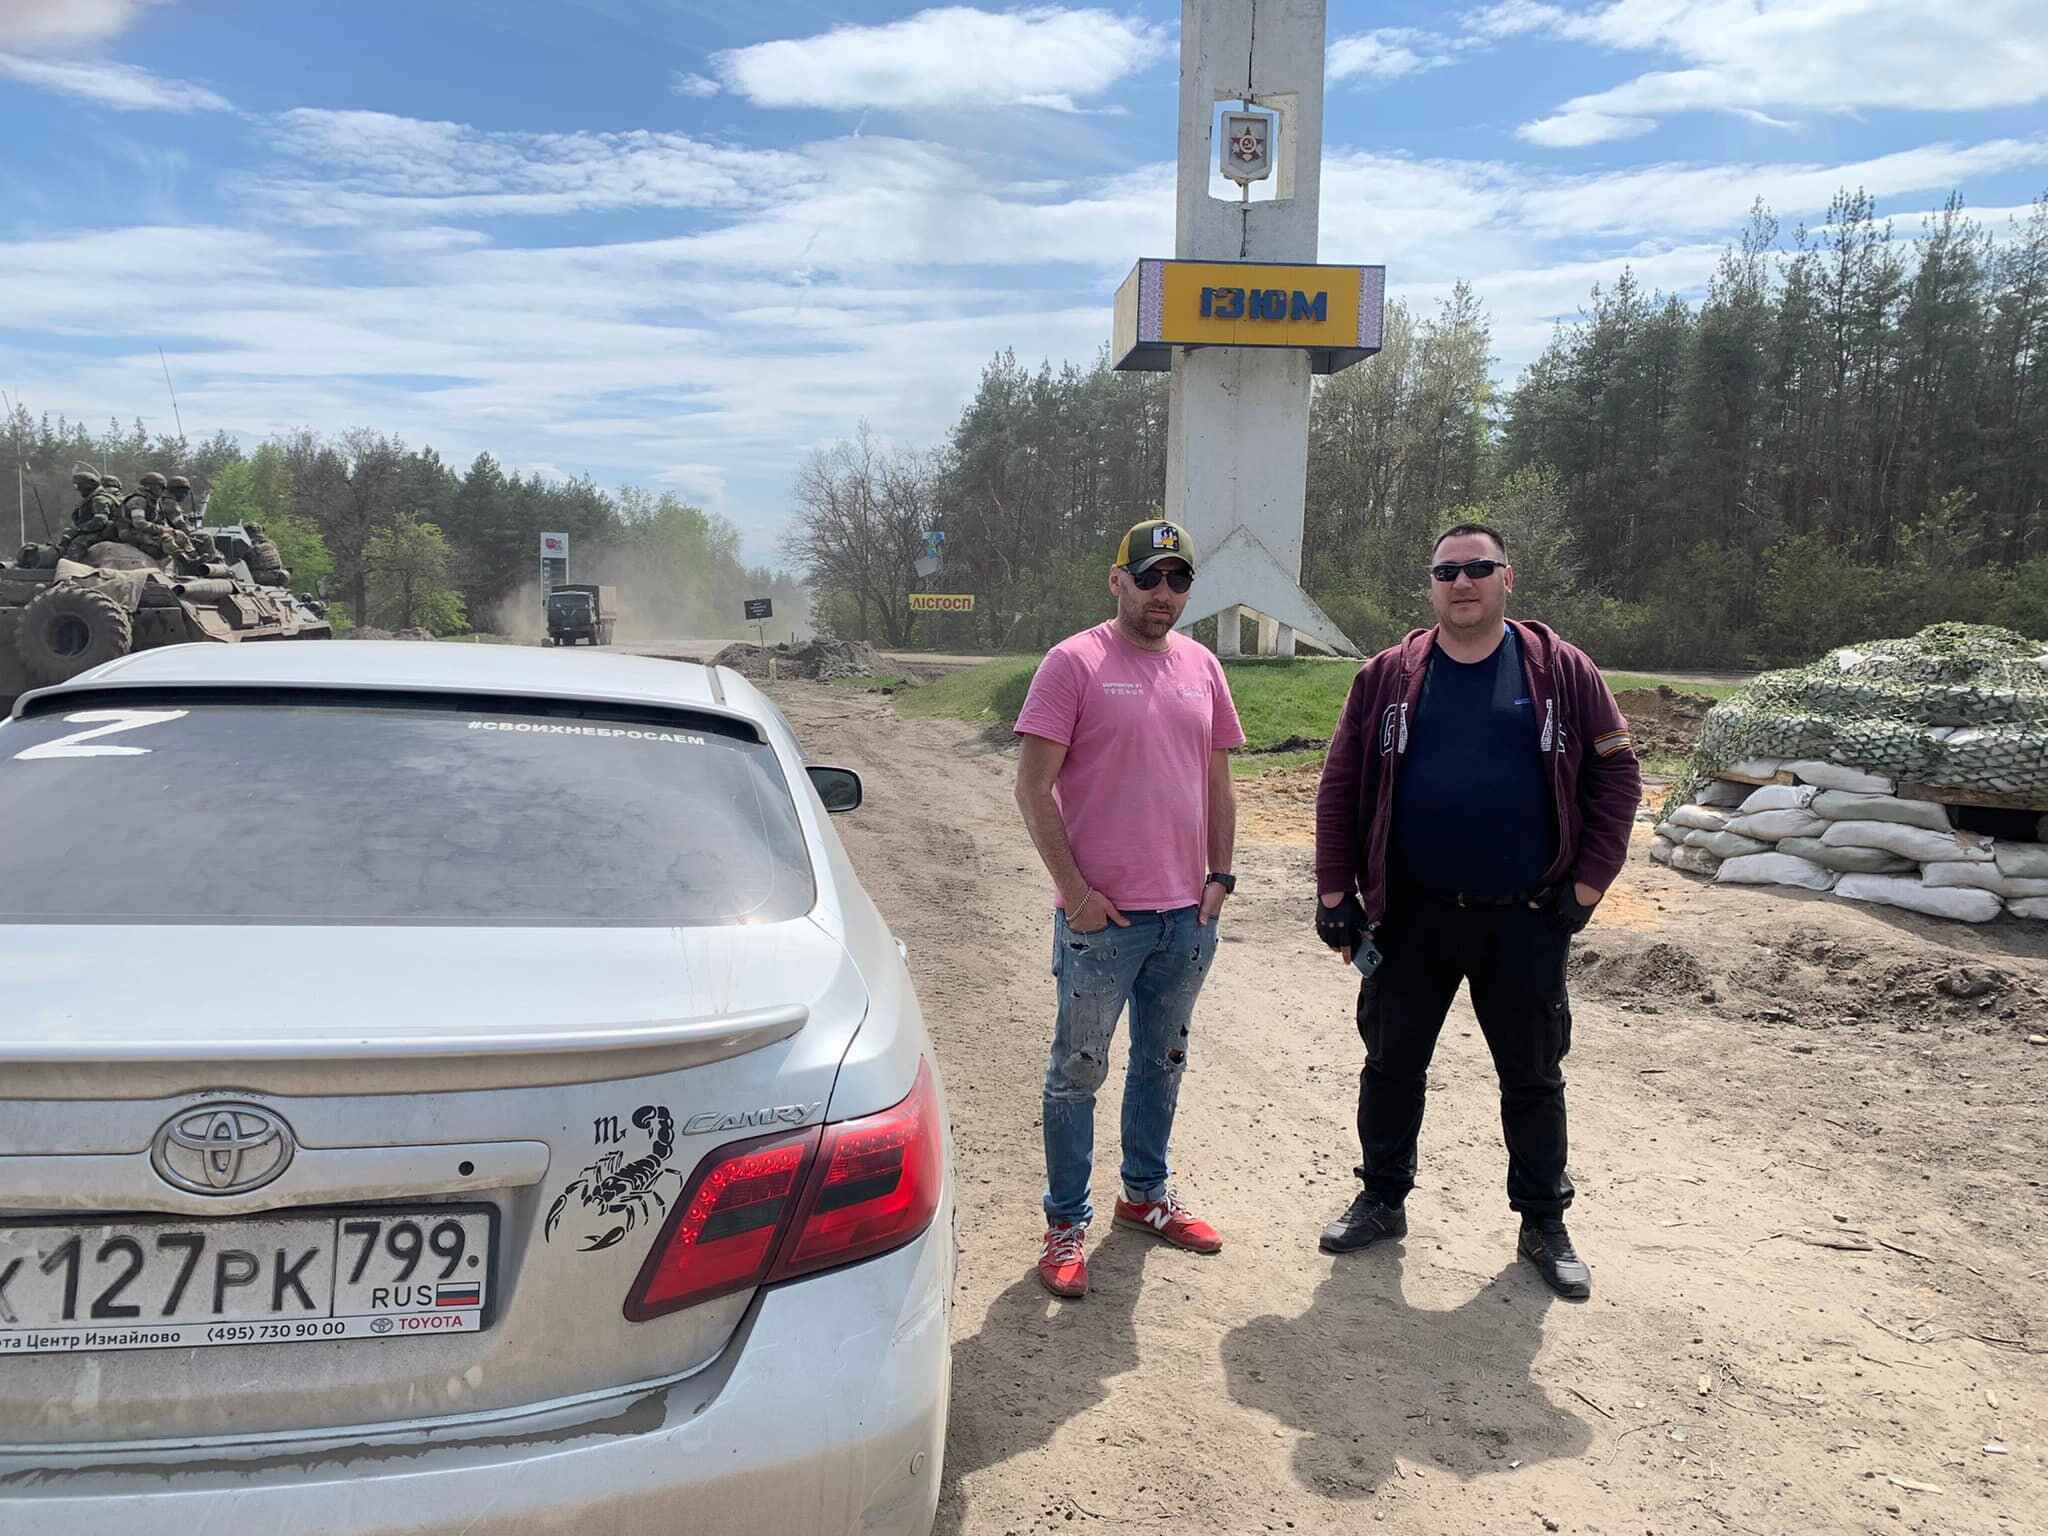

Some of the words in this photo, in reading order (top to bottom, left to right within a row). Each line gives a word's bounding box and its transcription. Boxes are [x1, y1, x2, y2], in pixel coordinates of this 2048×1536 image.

[1200, 286, 1328, 321] ІЗЮМ
[911, 597, 972, 609] ЛІСГОСП
[13, 709, 190, 760] Z
[467, 720, 706, 746] #СВОИХНЕБРОСАЕМ
[681, 1101, 823, 1136] CAMRY
[344, 1218, 466, 1285] 799
[372, 1285, 433, 1309] RUS
[0, 1337, 22, 1348] та
[26, 1334, 80, 1349] Центр
[85, 1330, 181, 1346] Измайлово
[207, 1326, 255, 1343] (495)
[259, 1324, 291, 1339] 730
[295, 1323, 318, 1337] 90
[322, 1321, 345, 1335] 00
[399, 1315, 463, 1330] TOYOTA
